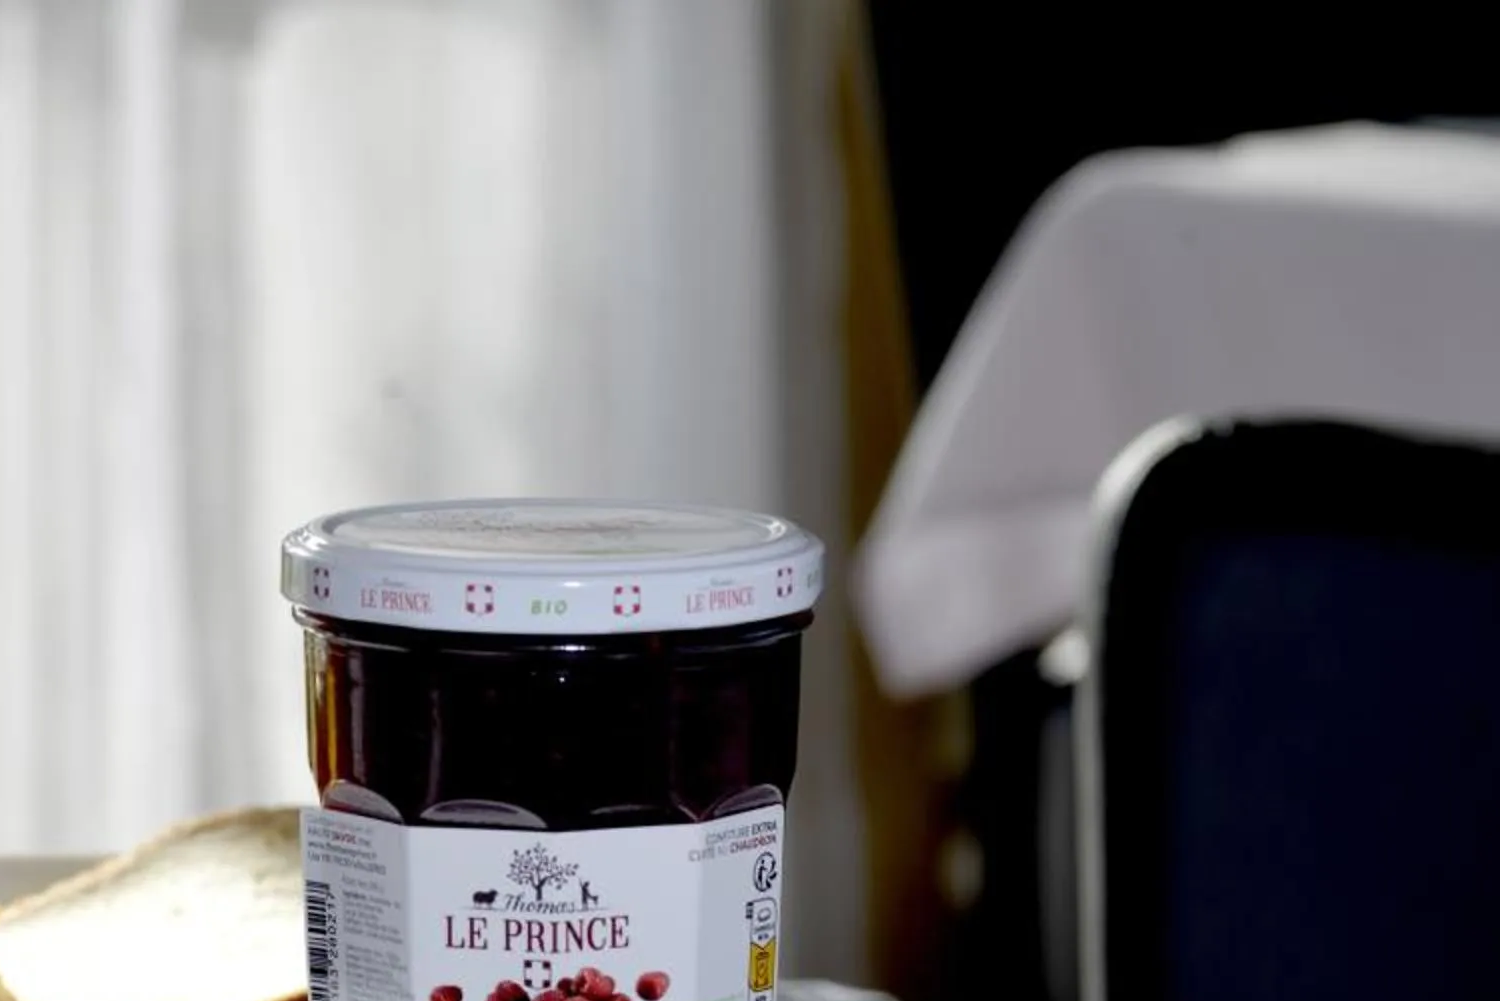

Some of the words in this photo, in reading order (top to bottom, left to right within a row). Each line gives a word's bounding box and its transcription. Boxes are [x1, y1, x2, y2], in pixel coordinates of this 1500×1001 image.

[360, 588, 378, 609] LE
[381, 590, 433, 614] PRINCE
[531, 599, 567, 615] BIO
[686, 594, 705, 613] LE
[709, 587, 755, 611] PRINCE
[752, 820, 777, 835] EXTRA
[501, 892, 578, 914] Thomas
[445, 916, 488, 950] LE
[504, 915, 630, 953] PRINCE
